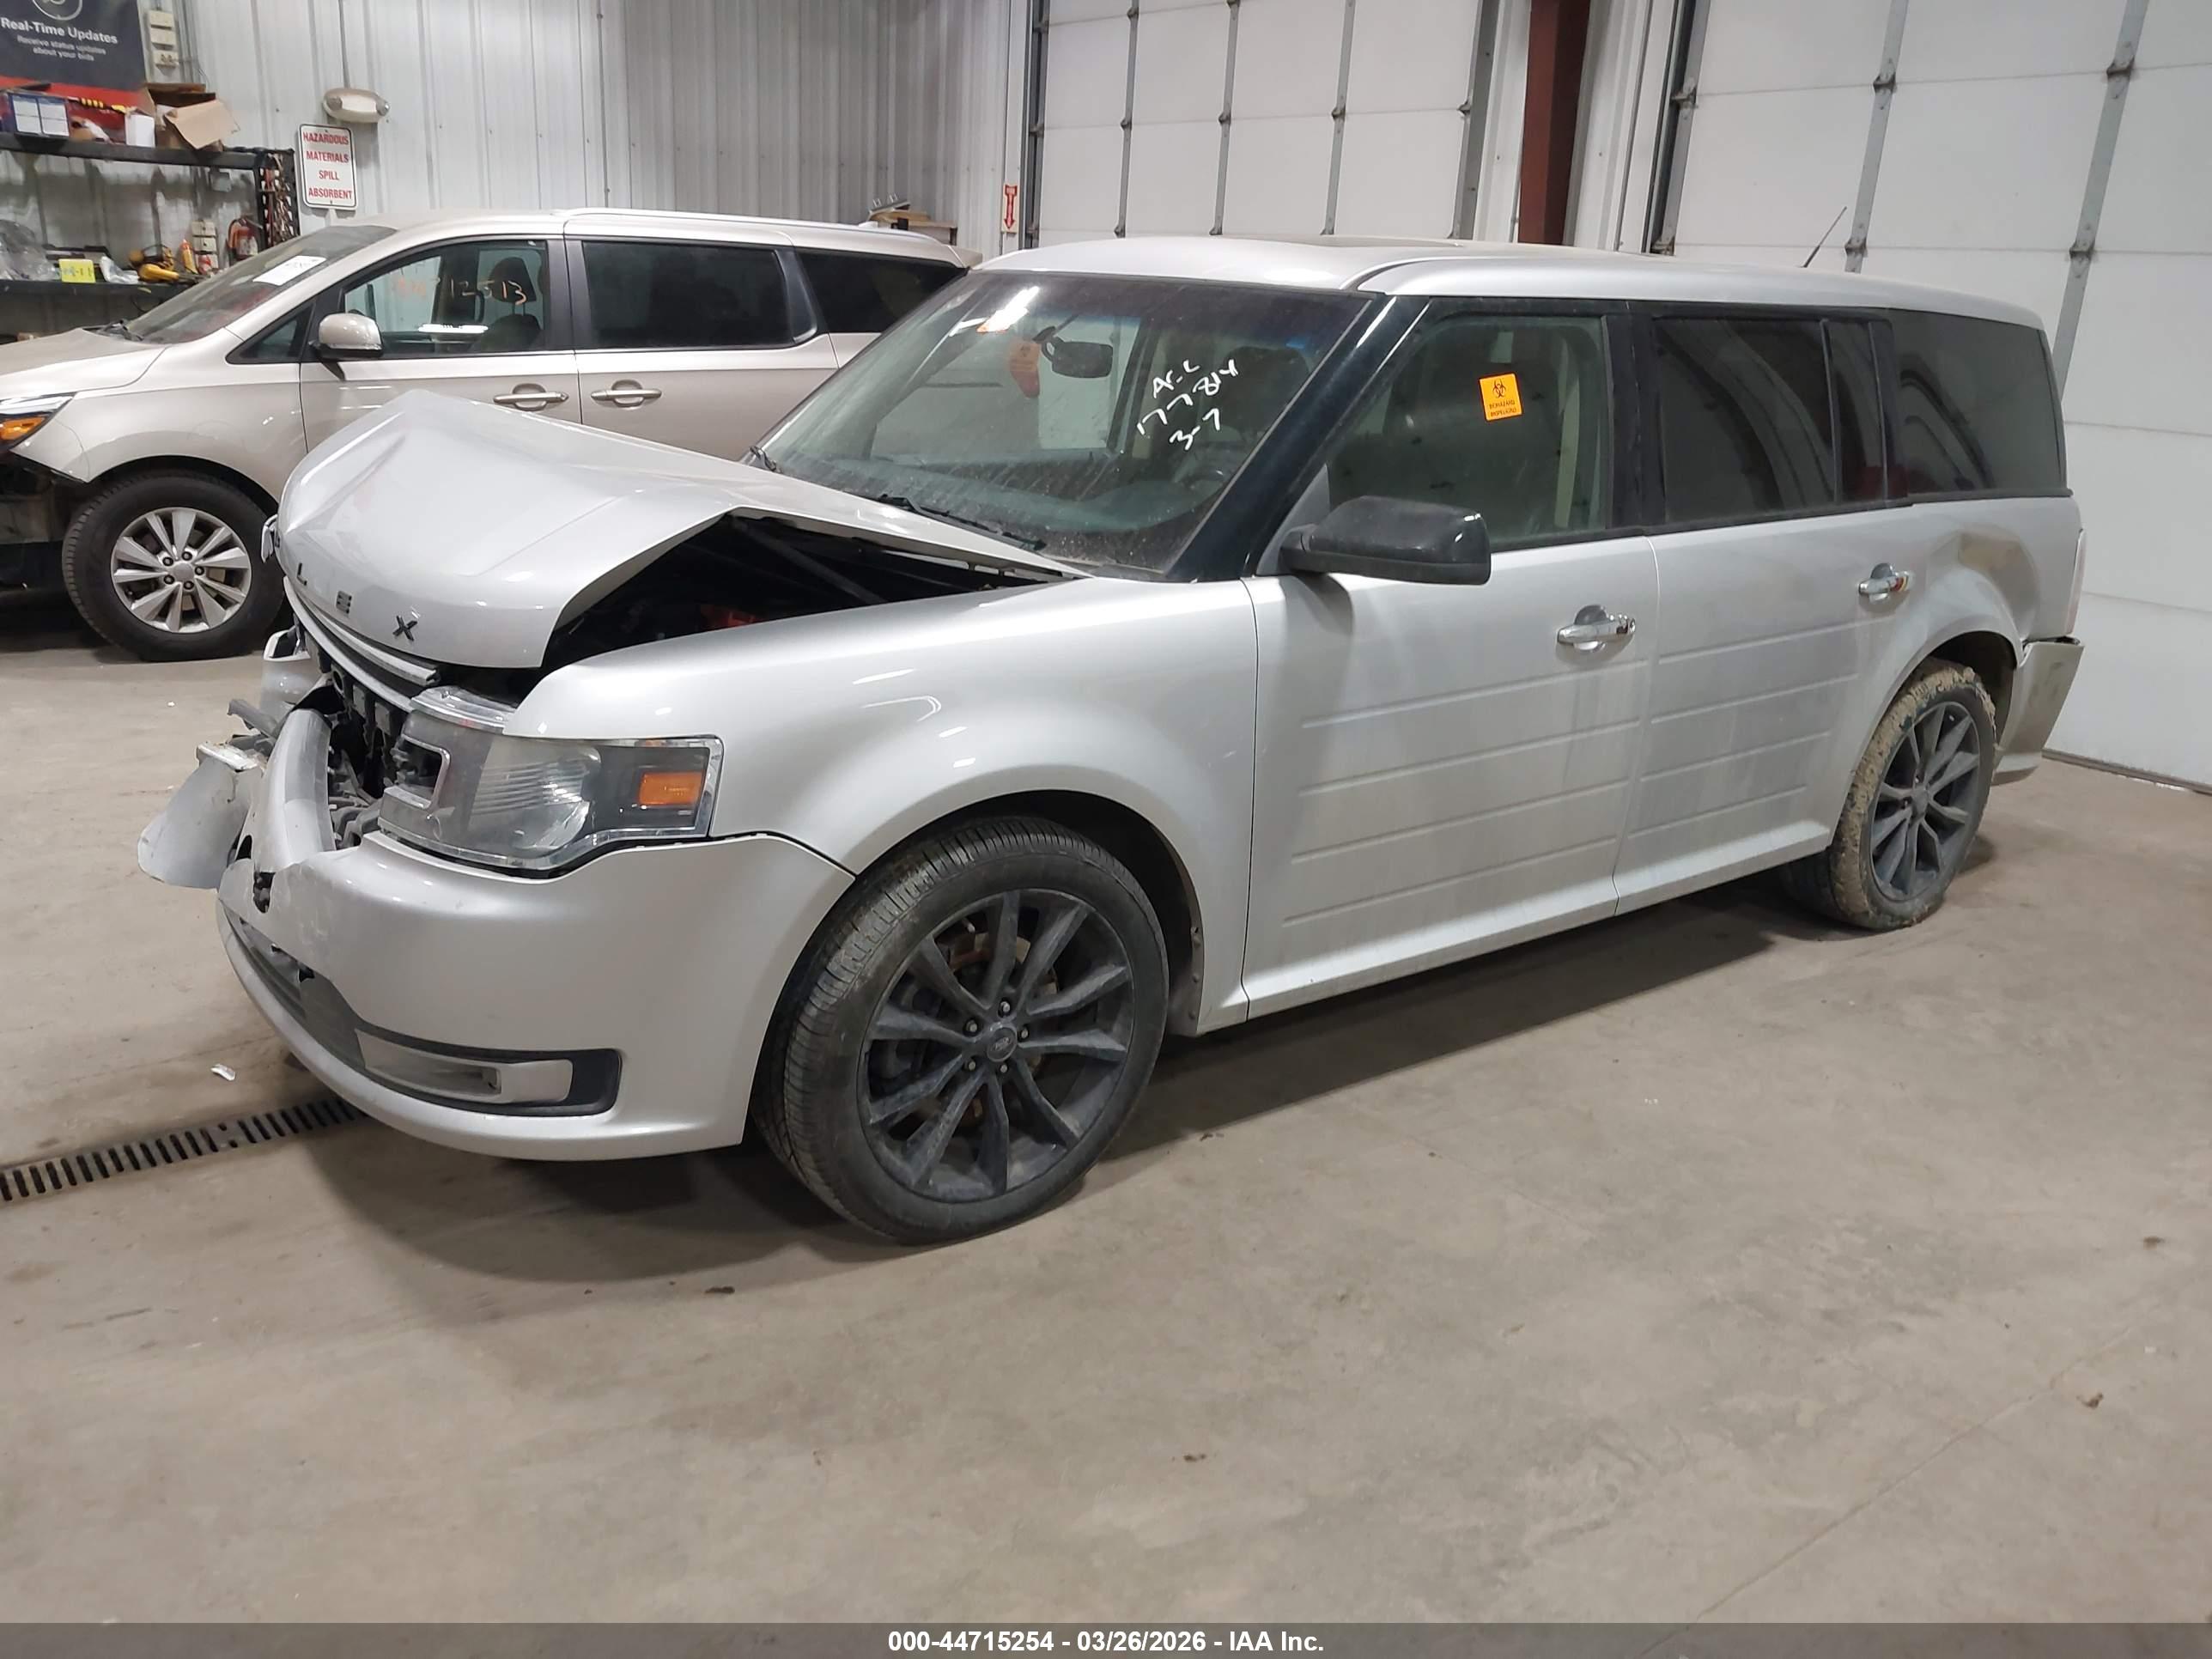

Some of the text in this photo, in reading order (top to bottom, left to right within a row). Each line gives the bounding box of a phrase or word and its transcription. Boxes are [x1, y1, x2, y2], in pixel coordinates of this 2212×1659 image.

[0, 17, 118, 44] Real-Time Updates
[302, 131, 349, 145] HAZARDOUS
[306, 150, 349, 163] MATERIALS
[319, 170, 339, 180] SPILL
[308, 187, 353, 199] ABSORBENT
